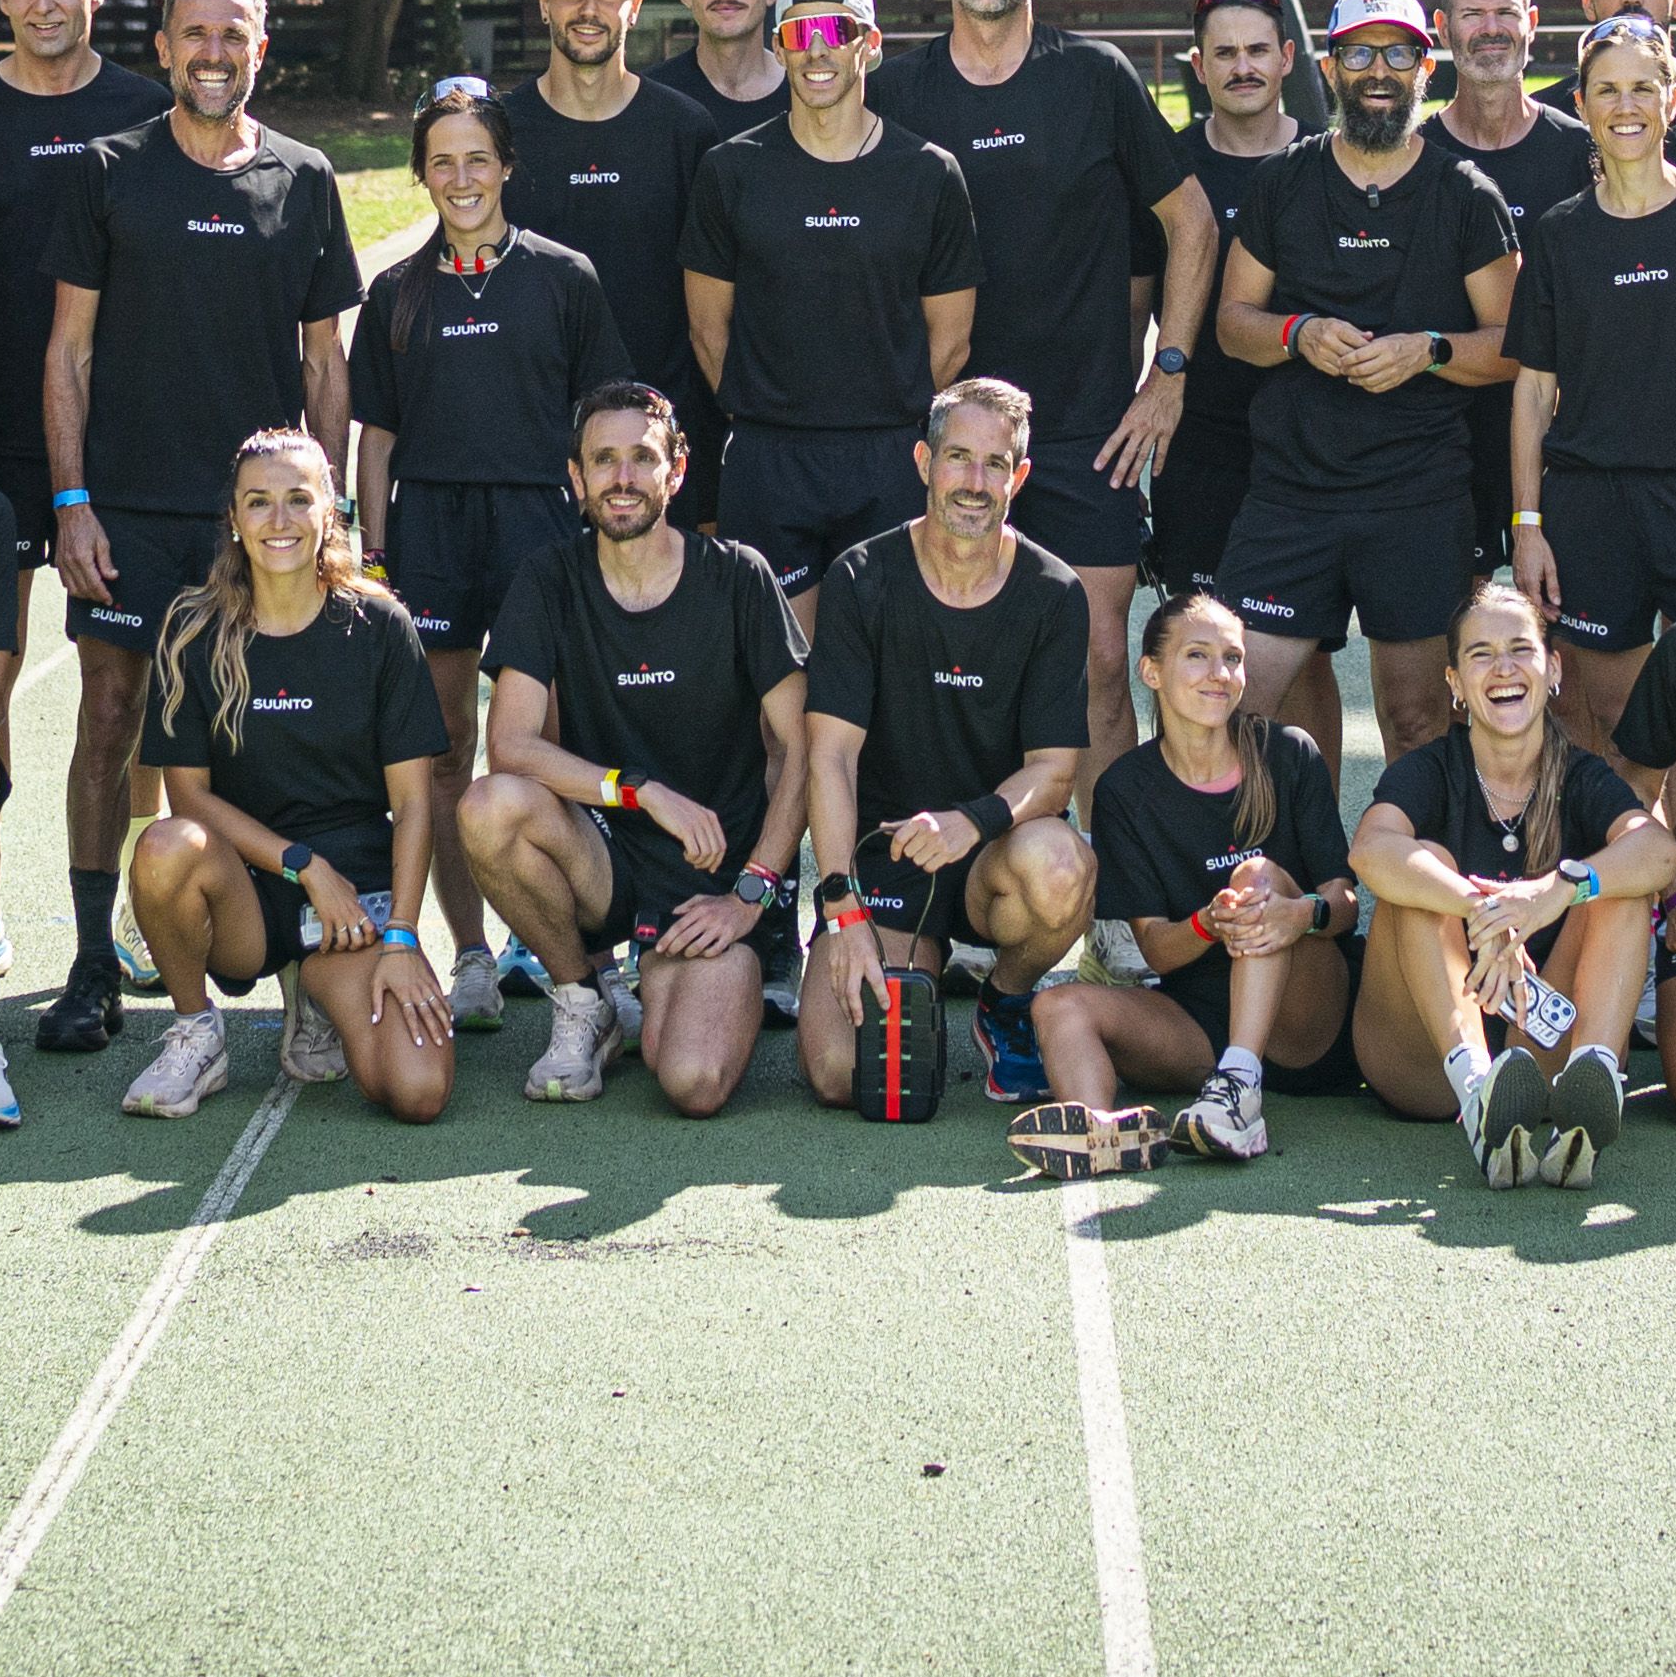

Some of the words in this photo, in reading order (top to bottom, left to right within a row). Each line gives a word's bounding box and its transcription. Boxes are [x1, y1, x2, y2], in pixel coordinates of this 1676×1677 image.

[972, 133, 1025, 150] SUUNTO
[31, 143, 84, 156] SUUNTO
[569, 172, 620, 185] SUUNTO
[187, 220, 244, 235] SUUNTO
[805, 216, 860, 227] SUUNTO
[1338, 236, 1390, 249] SUUNTO
[1614, 269, 1669, 285] SUUNTO
[442, 323, 498, 337] SUUNTO
[1241, 597, 1295, 619] SUUNTO
[90, 607, 143, 628] SUUNTO
[1560, 614, 1608, 636] SUUNTO
[618, 670, 675, 686] SUUNTO
[934, 671, 983, 687] SUUNTO
[252, 698, 313, 711] SUUNTO
